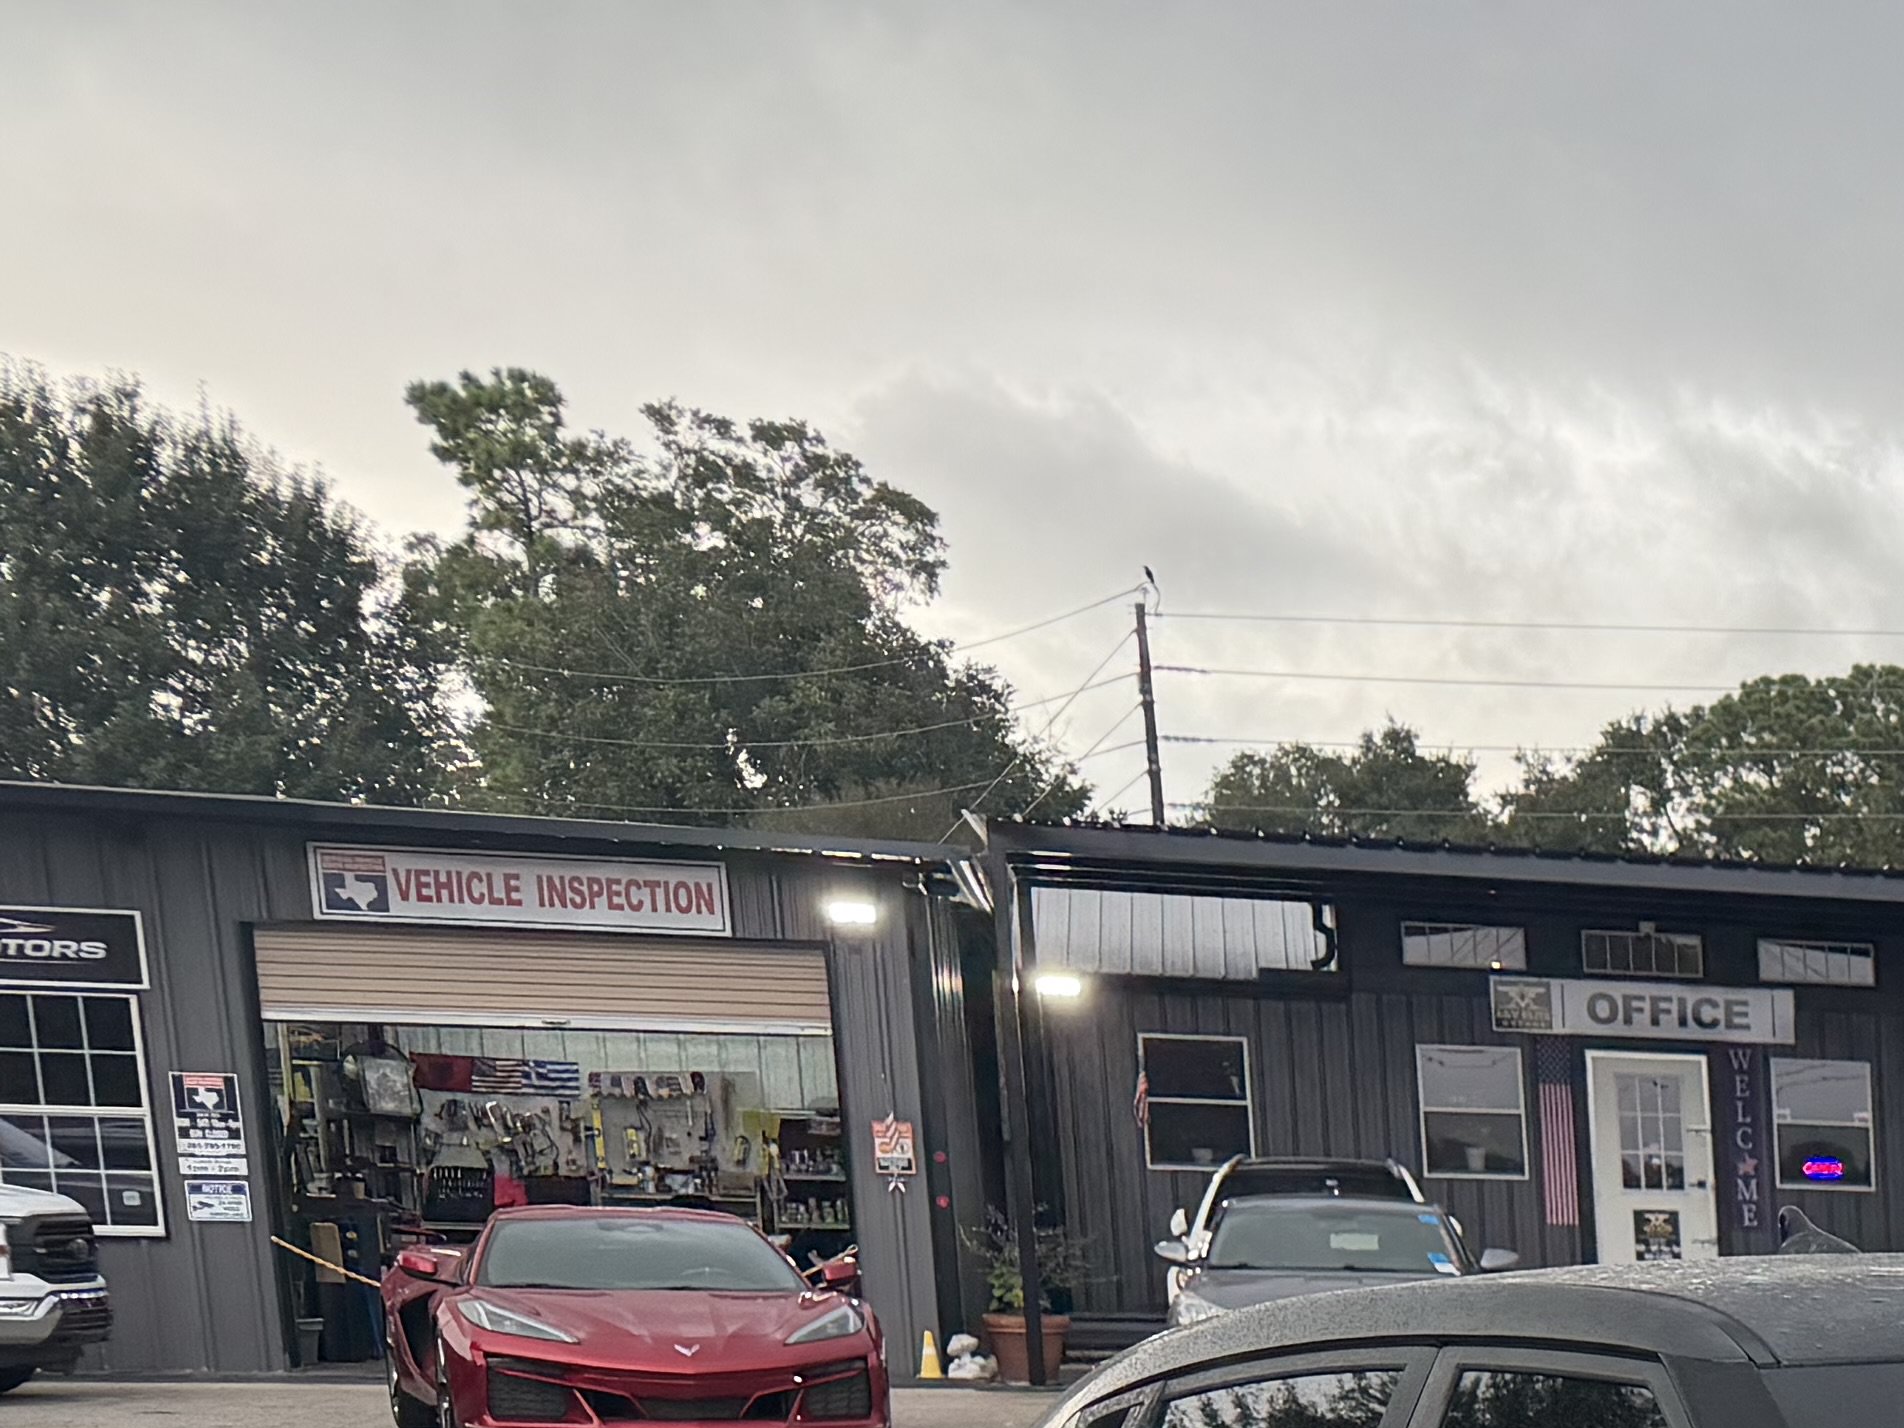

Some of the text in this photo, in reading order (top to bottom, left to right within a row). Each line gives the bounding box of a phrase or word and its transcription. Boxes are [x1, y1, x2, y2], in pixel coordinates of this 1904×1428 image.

[391, 867, 716, 916] VEHICLE INSPECTION
[0, 938, 108, 959] TORS
[1586, 992, 1752, 1031] OFFICE
[1729, 1049, 1758, 1227] WELCME
